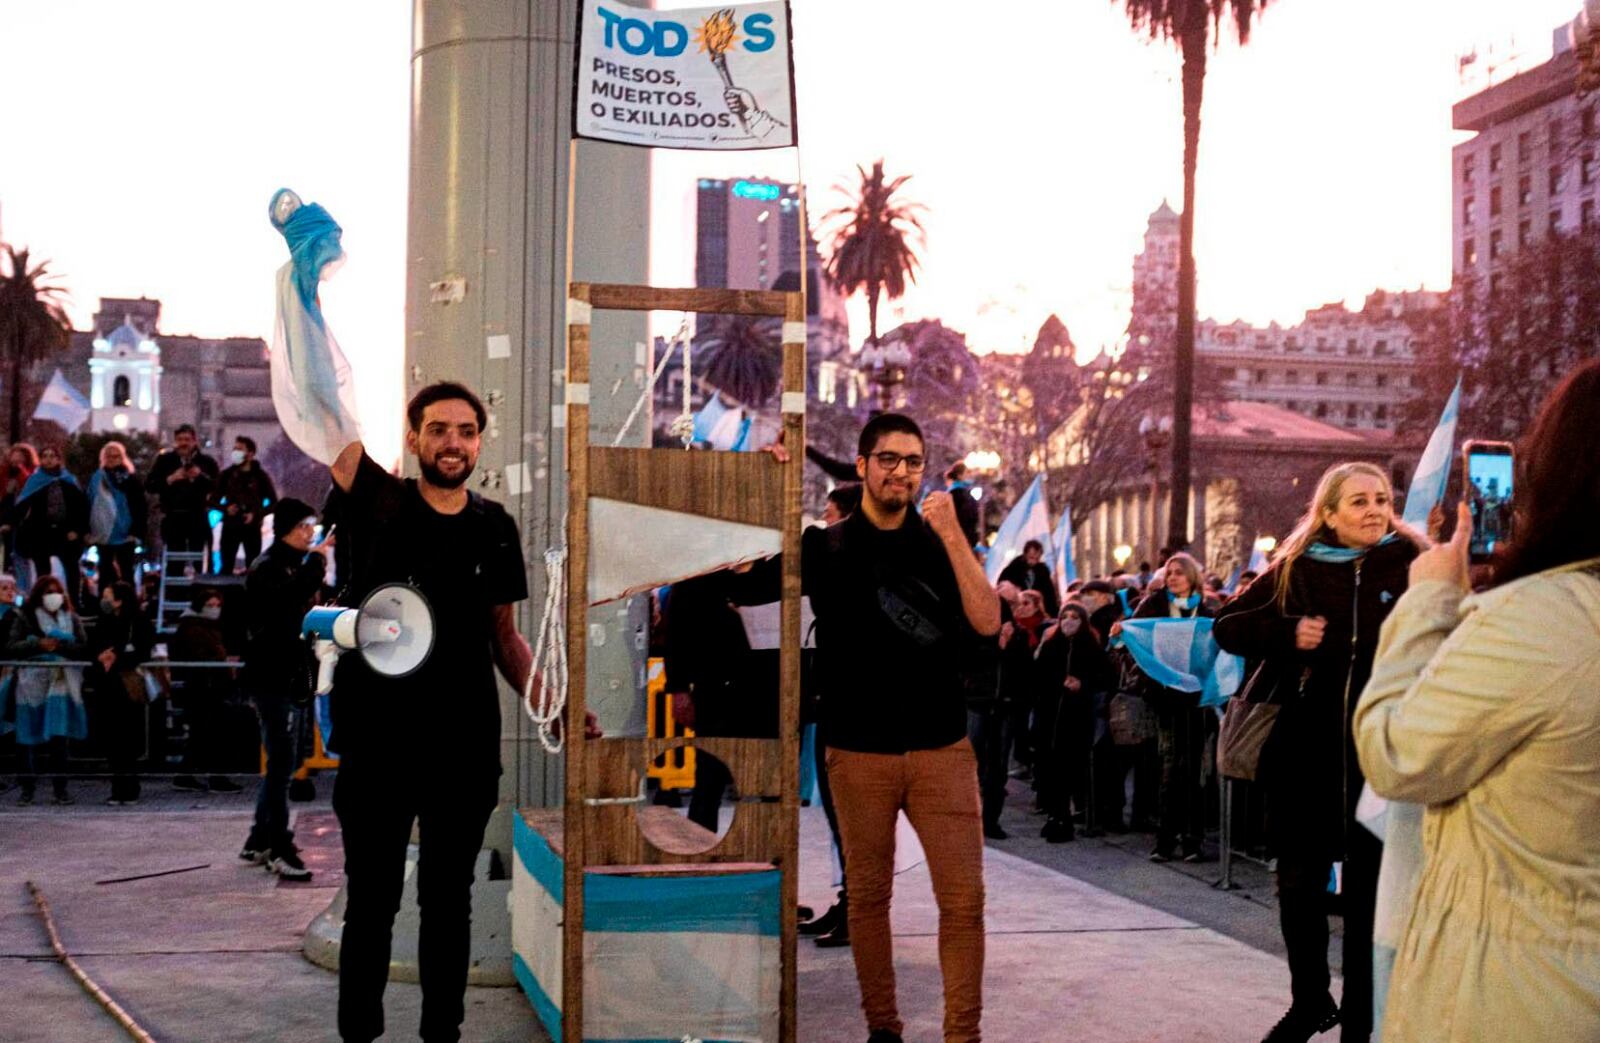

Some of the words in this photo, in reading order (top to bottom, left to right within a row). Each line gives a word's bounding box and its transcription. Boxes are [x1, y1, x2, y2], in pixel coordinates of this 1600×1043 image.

[592, 58, 681, 87] PRESOS,
[591, 80, 702, 108] MUERTOS,
[591, 102, 606, 118] O
[612, 107, 736, 128] EXILIADOS.
